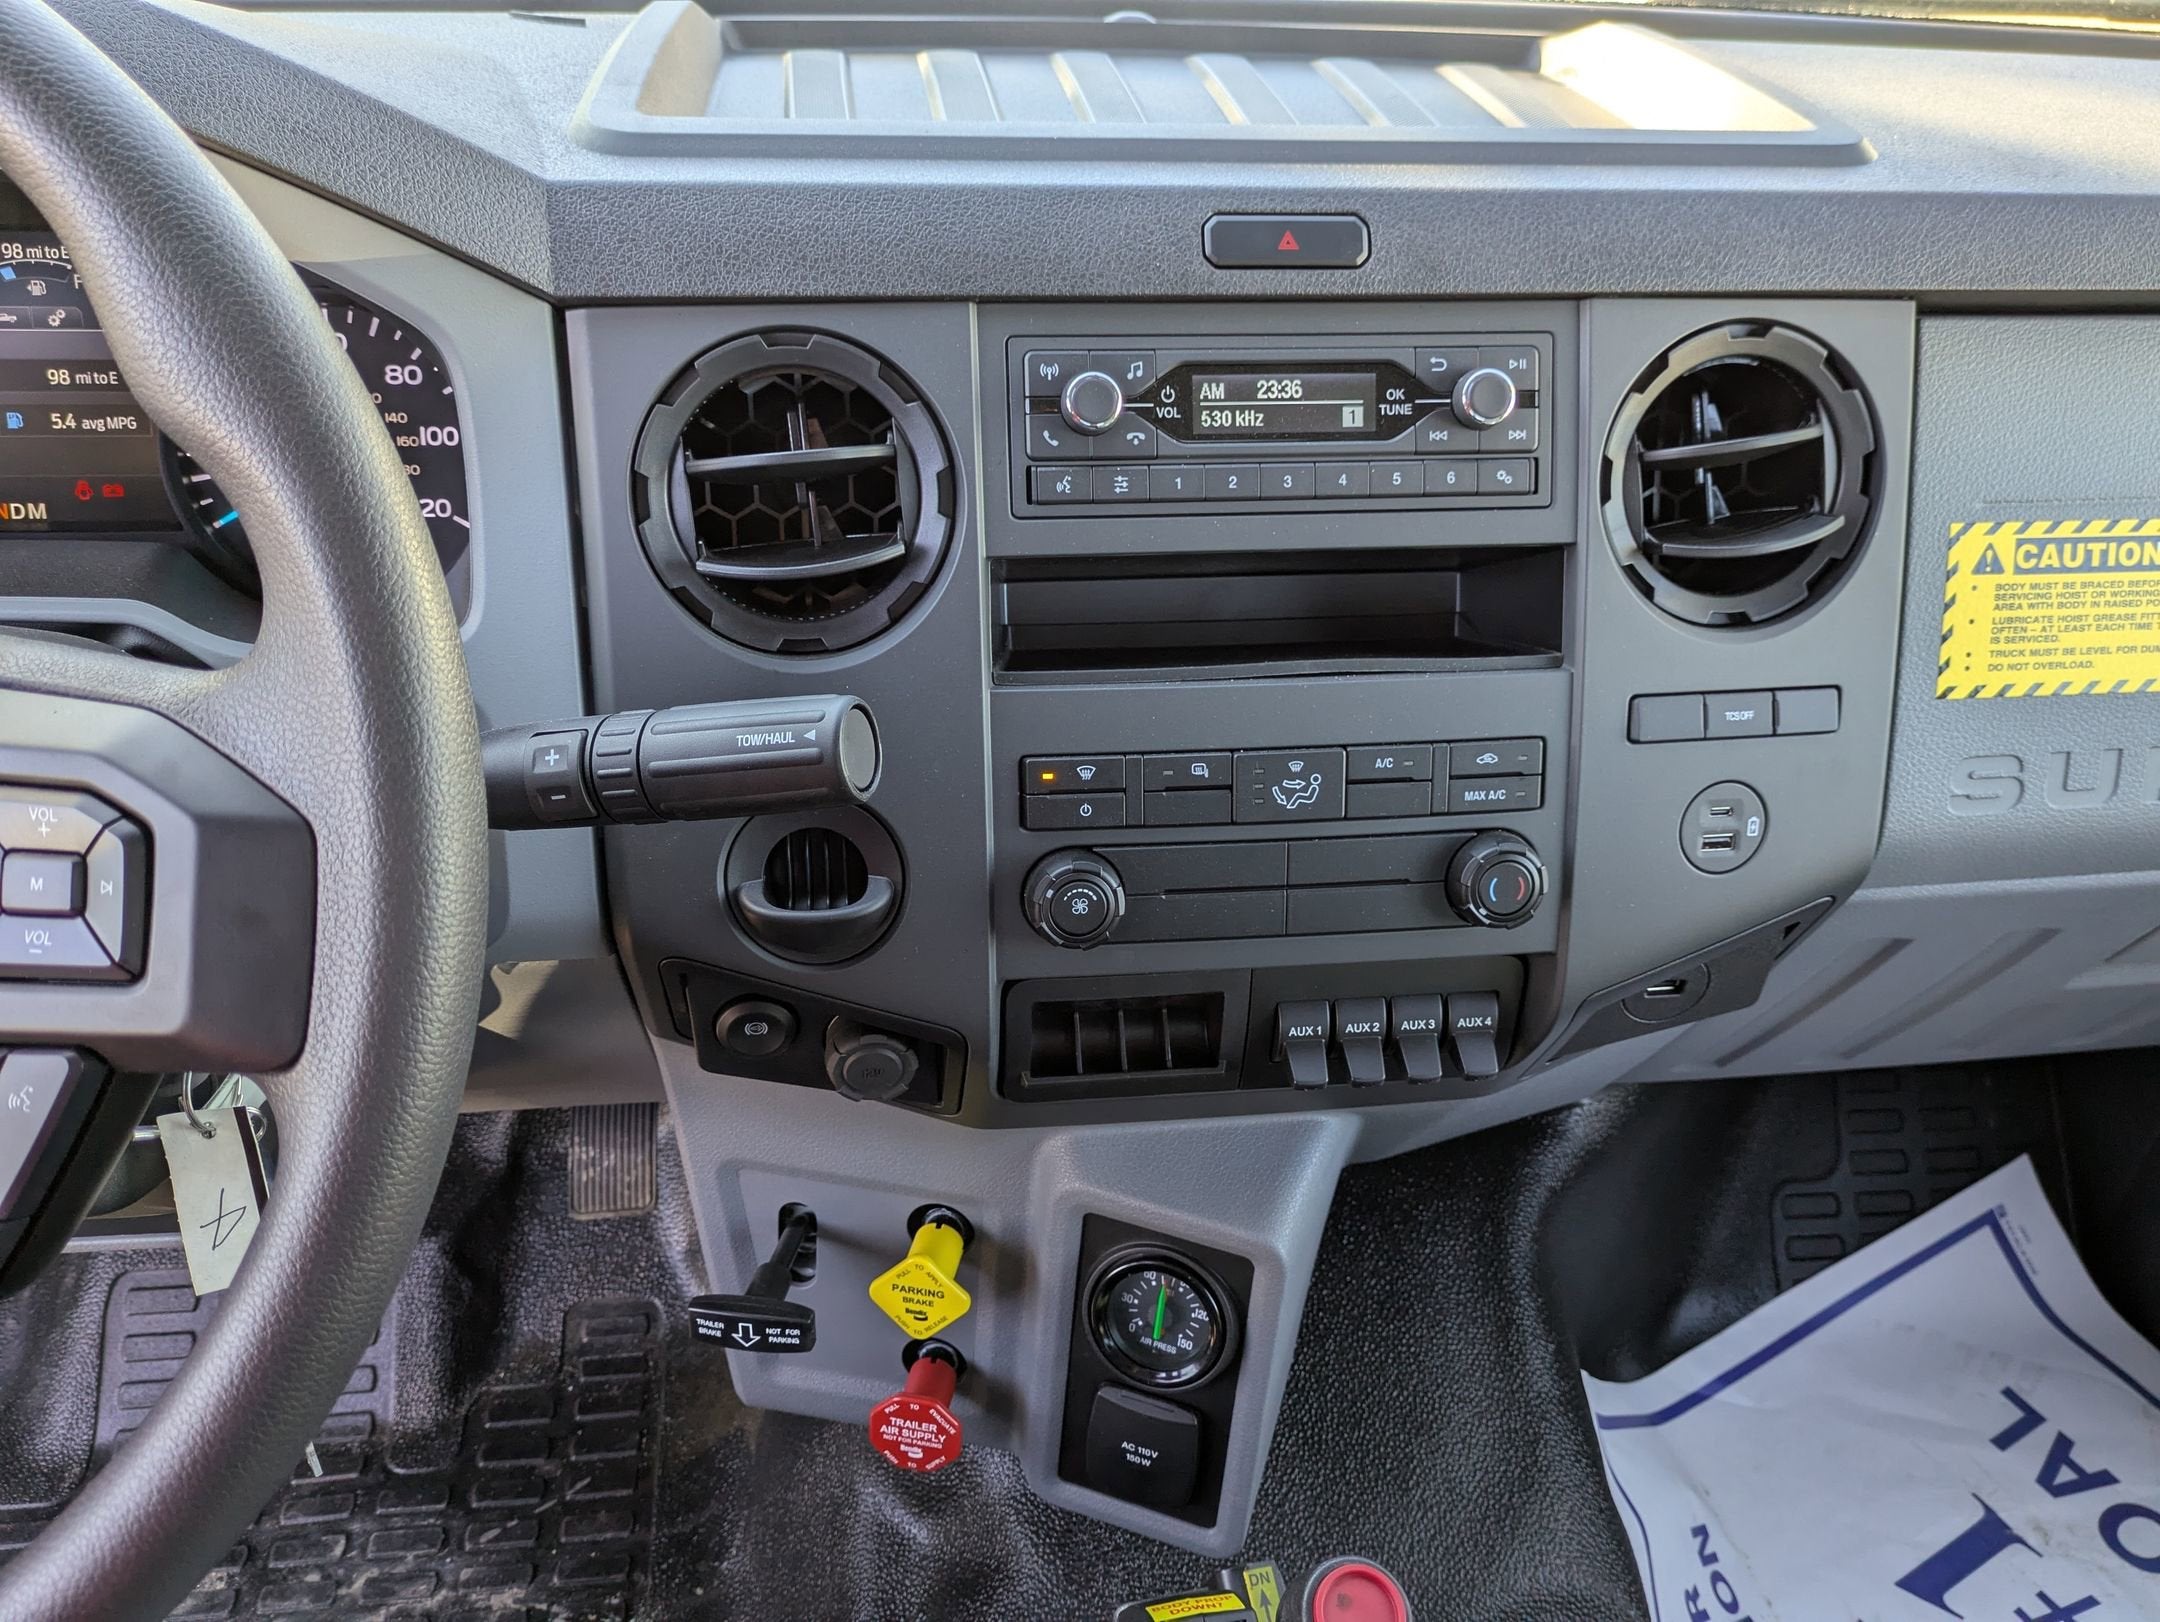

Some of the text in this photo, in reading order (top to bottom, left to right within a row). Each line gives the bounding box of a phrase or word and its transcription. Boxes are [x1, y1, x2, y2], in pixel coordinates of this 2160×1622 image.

[1, 243, 23, 259] 98
[26, 245, 42, 259] mi
[45, 245, 59, 259] to
[48, 369, 119, 386] 98 mi to E
[384, 364, 423, 385] 80
[1200, 380, 1303, 400] AM 23:36
[1386, 388, 1405, 401] OK
[1156, 406, 1181, 419] VOL
[1378, 403, 1413, 416] TUNE
[50, 412, 137, 432] 5.4 avg MPG
[385, 412, 408, 424] 140
[1201, 410, 1264, 427] 530 kHz
[1348, 409, 1357, 426] 1
[396, 435, 419, 447] 160
[419, 426, 459, 446] 100
[1175, 477, 1182, 489] 1
[1228, 476, 1237, 489] 2
[1283, 476, 1292, 488] 3
[1338, 474, 1347, 486] 4
[1392, 472, 1401, 485] 5
[1446, 472, 1456, 484] 6
[2016, 541, 2160, 569] CAUTION
[1995, 583, 2026, 592] BODY
[2029, 582, 2058, 591] MUST
[2062, 582, 2076, 590] BE
[2080, 580, 2125, 590] BRACED
[1994, 592, 2053, 602] SERVICING
[2056, 591, 2088, 600] HOIST
[2090, 590, 2106, 599] OR
[1992, 602, 2023, 611] AREA
[2027, 602, 2053, 610] WITH
[2057, 601, 2087, 610] BODY
[2090, 600, 2101, 608] IN
[2104, 599, 2143, 608] RAISED
[1992, 615, 2054, 625] LUBRICATE
[2057, 614, 2090, 623] HOIST
[2093, 613, 2137, 622] GREASE
[1990, 626, 2028, 635] OFTEN
[2040, 625, 2054, 633] AT
[2058, 623, 2092, 632] LEAST
[2096, 623, 2125, 631] EACH
[2129, 622, 2153, 630] TIME
[1989, 636, 2000, 644] IS
[1988, 649, 2026, 658] TRUCK
[2029, 648, 2058, 657] MUST
[2062, 647, 2076, 656] BE
[2079, 646, 2112, 655] LEVEL
[2116, 645, 2138, 654] FOR
[1987, 663, 2004, 672] DO
[2007, 662, 2030, 671] NOT
[736, 731, 796, 747] TOW/HAUL
[1375, 757, 1394, 769] A/C
[1464, 789, 1506, 801] MAX A/C
[28, 806, 58, 822] VOL
[30, 877, 43, 891] M
[24, 929, 52, 945] VOL
[1345, 1022, 1380, 1034] AUX 2
[1401, 1019, 1436, 1031] AUX 3
[1457, 1016, 1492, 1028] AUX 4
[1289, 1026, 1323, 1037] AUX 1
[891, 1283, 945, 1299] PARKING
[902, 1296, 934, 1307] BRAKE
[1121, 1292, 1134, 1304] 30
[695, 1318, 725, 1330] TRAILER
[698, 1327, 722, 1338] BRAKE
[765, 1327, 801, 1336] NOT FOR
[768, 1336, 801, 1344] PARKING
[1140, 1335, 1177, 1354] AIR PRESS
[1177, 1336, 1193, 1350] 150
[909, 1403, 920, 1411] TO
[889, 1416, 938, 1433] TRAILER
[880, 1424, 946, 1443] AIR SUPPLY
[883, 1433, 897, 1441] NOT
[1121, 1441, 1136, 1451] AC
[1248, 1571, 1271, 1587] DN
[1151, 1595, 1233, 1613] BODY PROP
